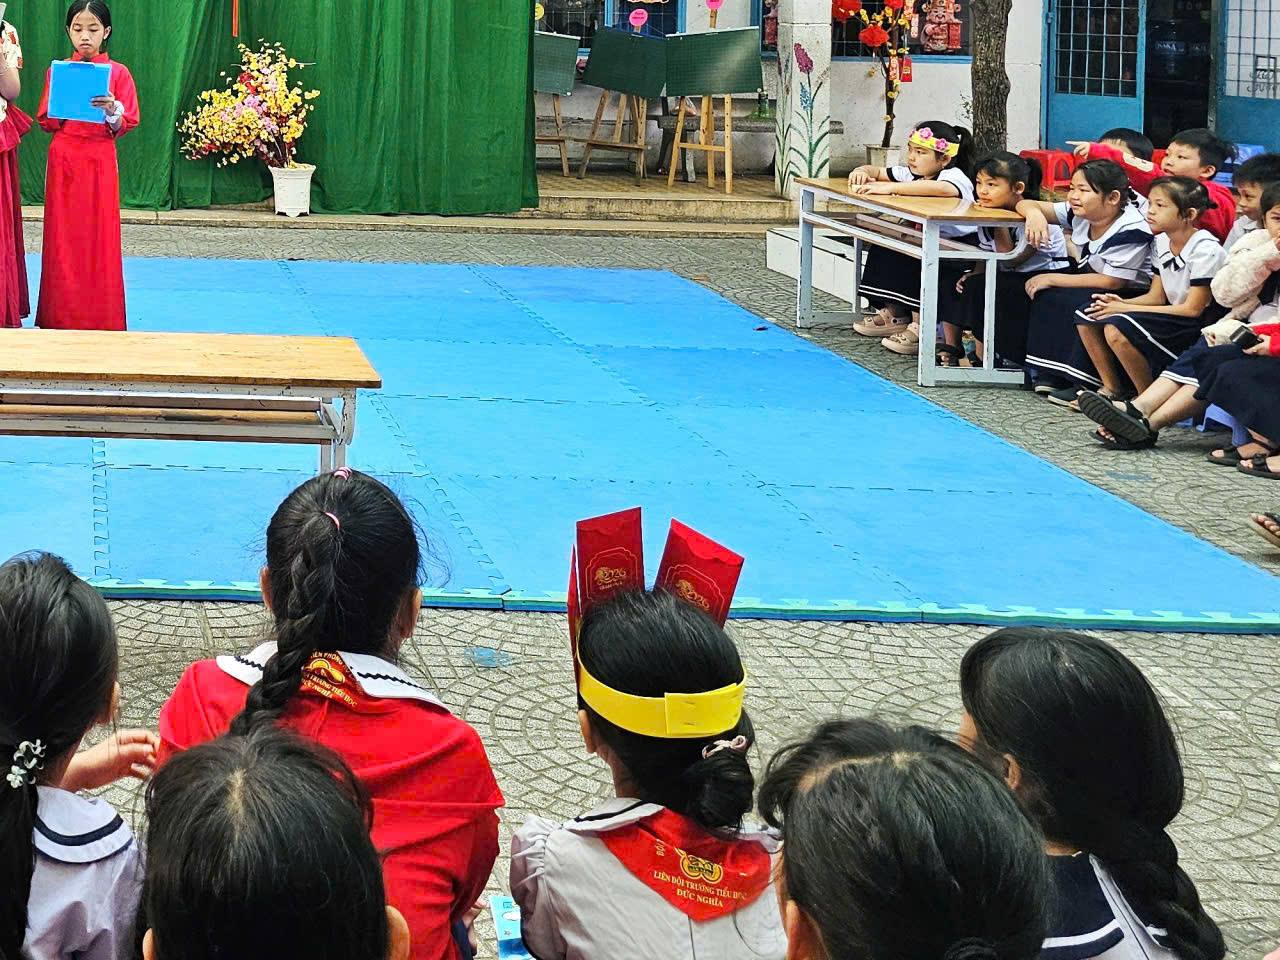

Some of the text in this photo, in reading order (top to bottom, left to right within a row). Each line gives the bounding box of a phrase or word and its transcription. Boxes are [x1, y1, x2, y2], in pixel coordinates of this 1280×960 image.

[323, 652, 343, 665] PHONG
[653, 870, 671, 882] LIÊN
[685, 880, 715, 895] TRƯỜNG
[676, 888, 724, 907] ĐỨC NGHĨA
